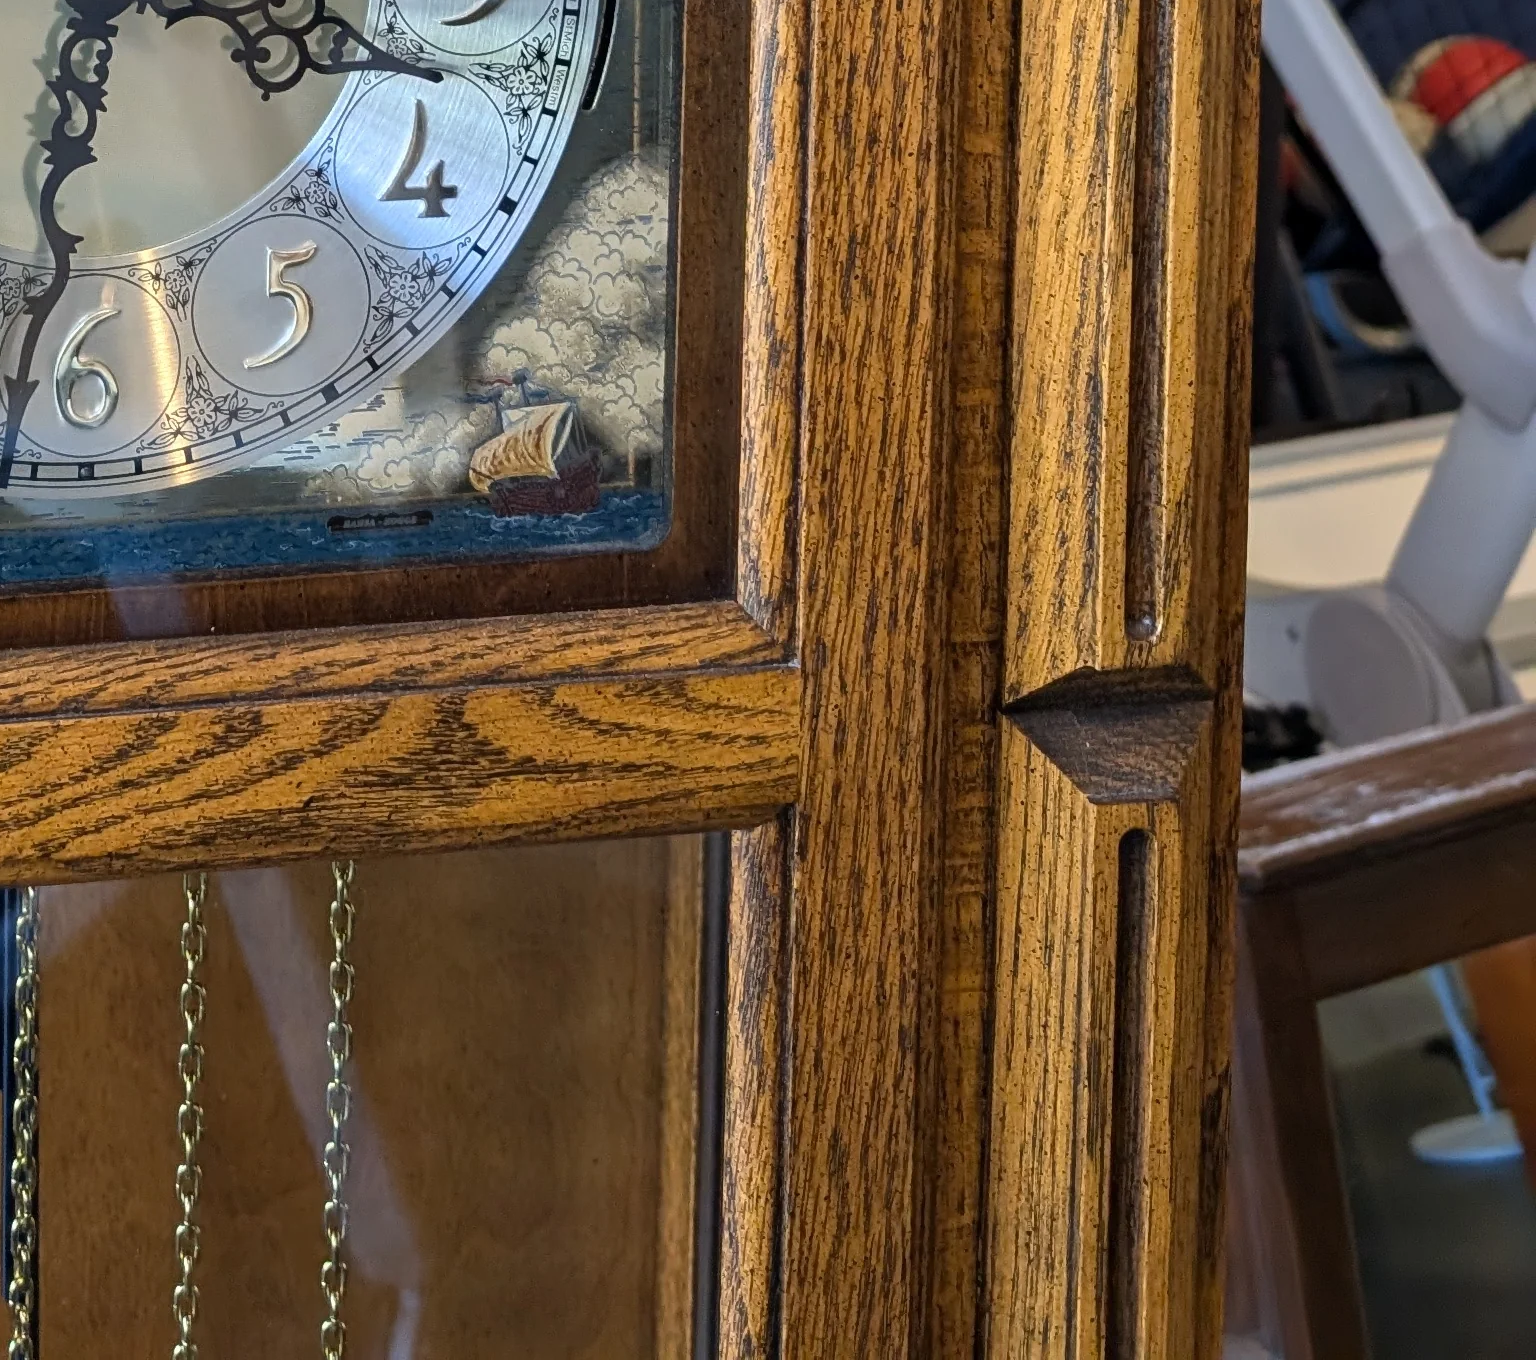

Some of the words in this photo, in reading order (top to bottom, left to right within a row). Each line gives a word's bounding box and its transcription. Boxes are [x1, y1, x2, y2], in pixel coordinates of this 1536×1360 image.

[548, 69, 566, 106] Westm
[379, 98, 459, 219] 4
[244, 240, 318, 369] 5
[53, 307, 121, 429] 6
